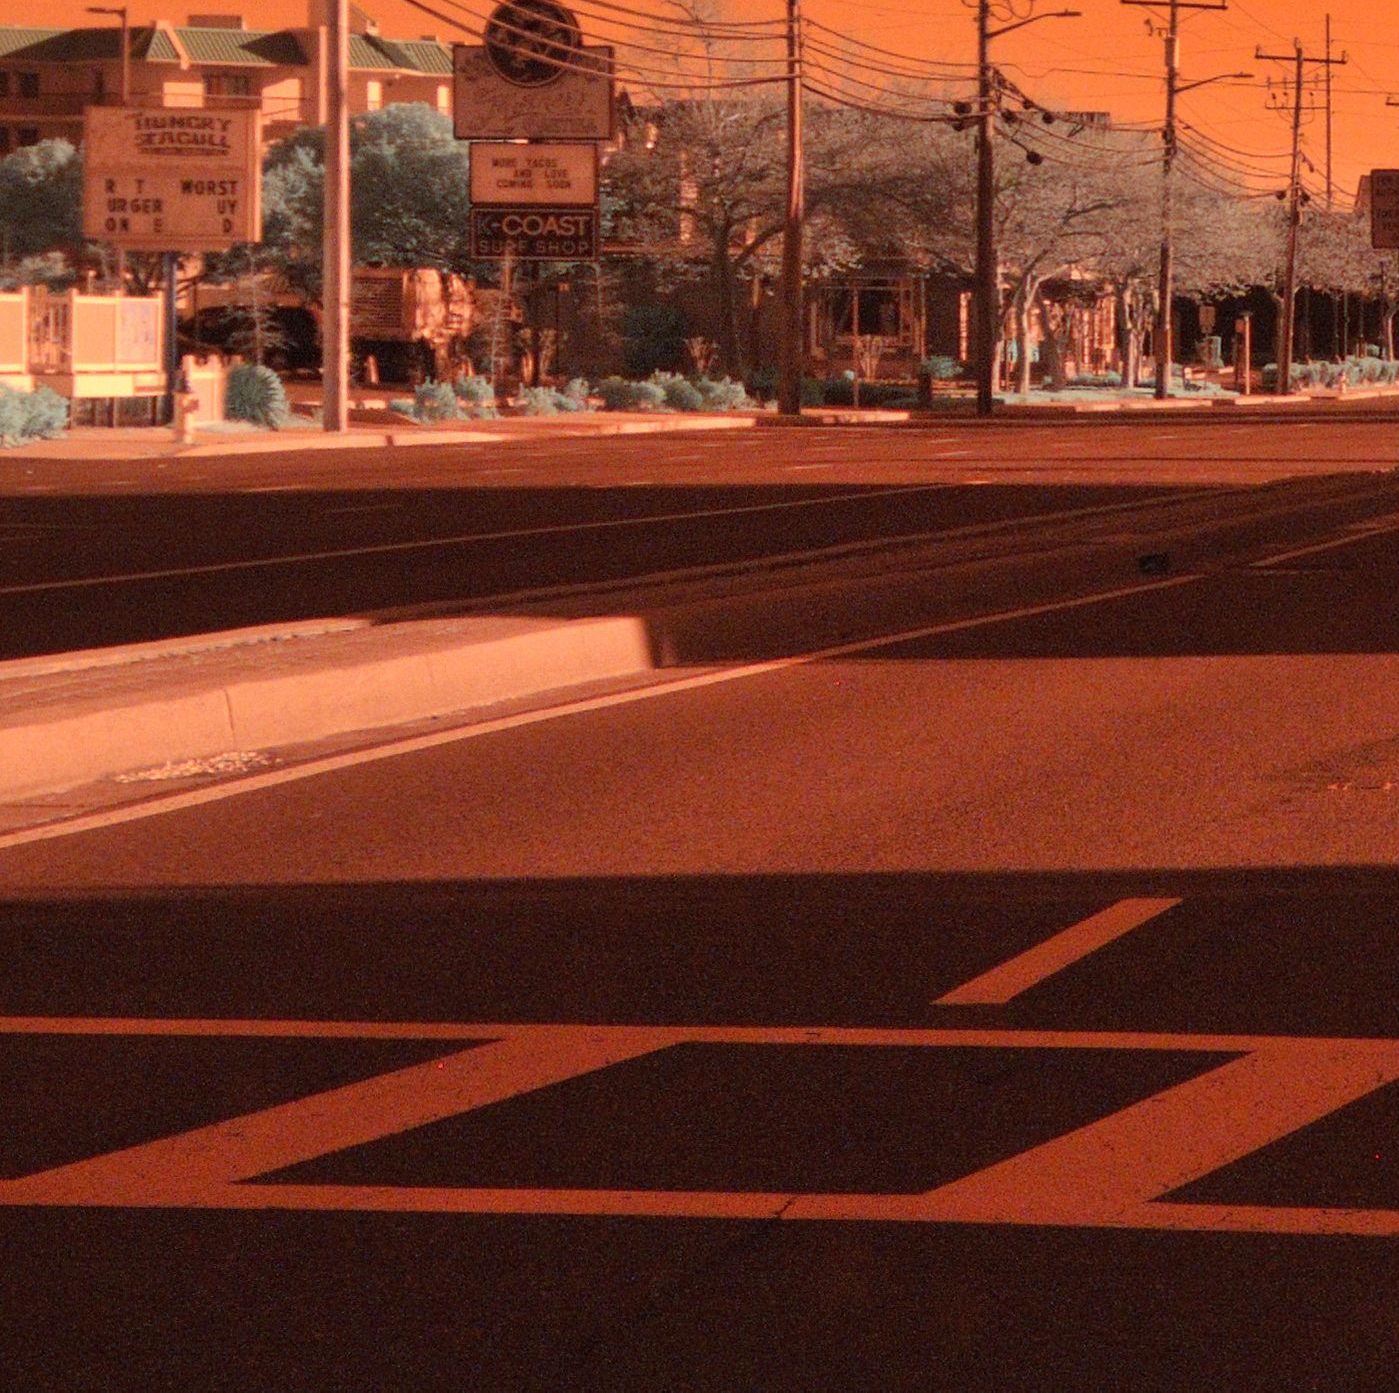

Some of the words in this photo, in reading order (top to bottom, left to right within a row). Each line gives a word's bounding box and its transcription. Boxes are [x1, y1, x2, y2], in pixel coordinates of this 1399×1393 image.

[134, 115, 232, 132] HUNGRY
[134, 132, 232, 149] SEAGULL
[181, 179, 238, 196] WORST
[477, 215, 590, 236] K-COAST
[479, 240, 528, 254] SURF
[536, 240, 589, 255] SHOP
